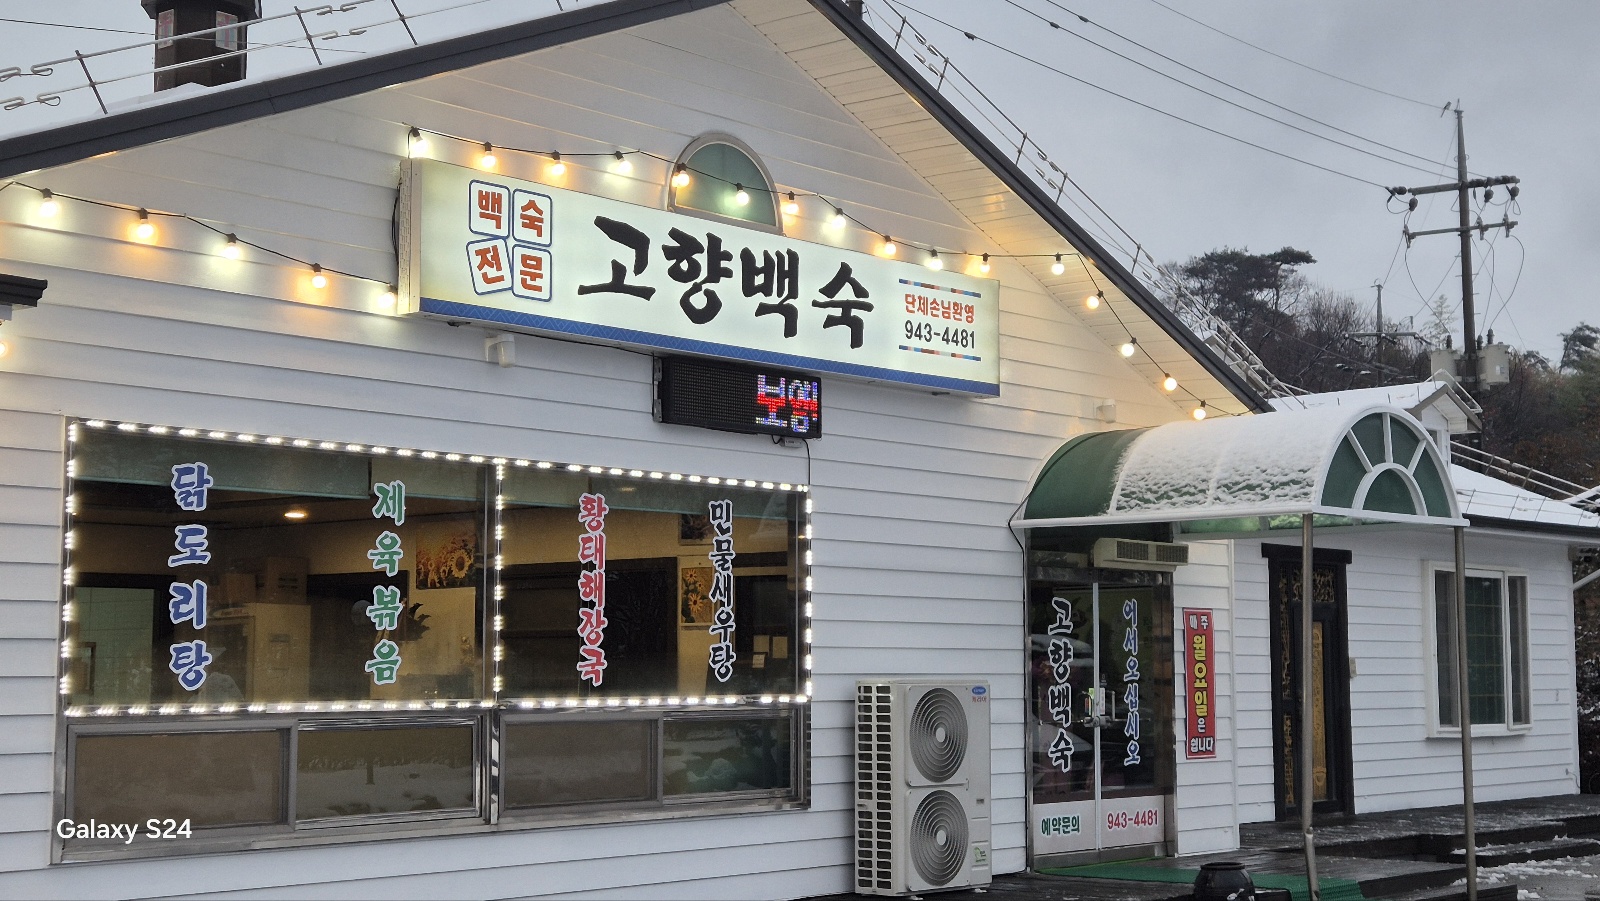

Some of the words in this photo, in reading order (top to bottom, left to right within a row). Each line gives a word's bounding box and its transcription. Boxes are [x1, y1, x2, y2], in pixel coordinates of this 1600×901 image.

[477, 189, 544, 238] 백숙
[474, 244, 544, 293] 전문
[577, 214, 876, 350] 고향백숙
[904, 293, 975, 324] 단체손님환영
[904, 319, 975, 349] 943-4481
[168, 461, 214, 691] 닭도리탕
[364, 479, 406, 686] 제육볶음
[577, 492, 609, 687] 황태해장국
[708, 499, 736, 682] 민물새우탕
[1047, 596, 1074, 773] 고향백숙
[1123, 598, 1141, 766] 어서오십시오
[1190, 736, 1214, 753] 쉽니다
[1040, 814, 1081, 837] 예약문의
[1107, 808, 1159, 831] 943-4481
